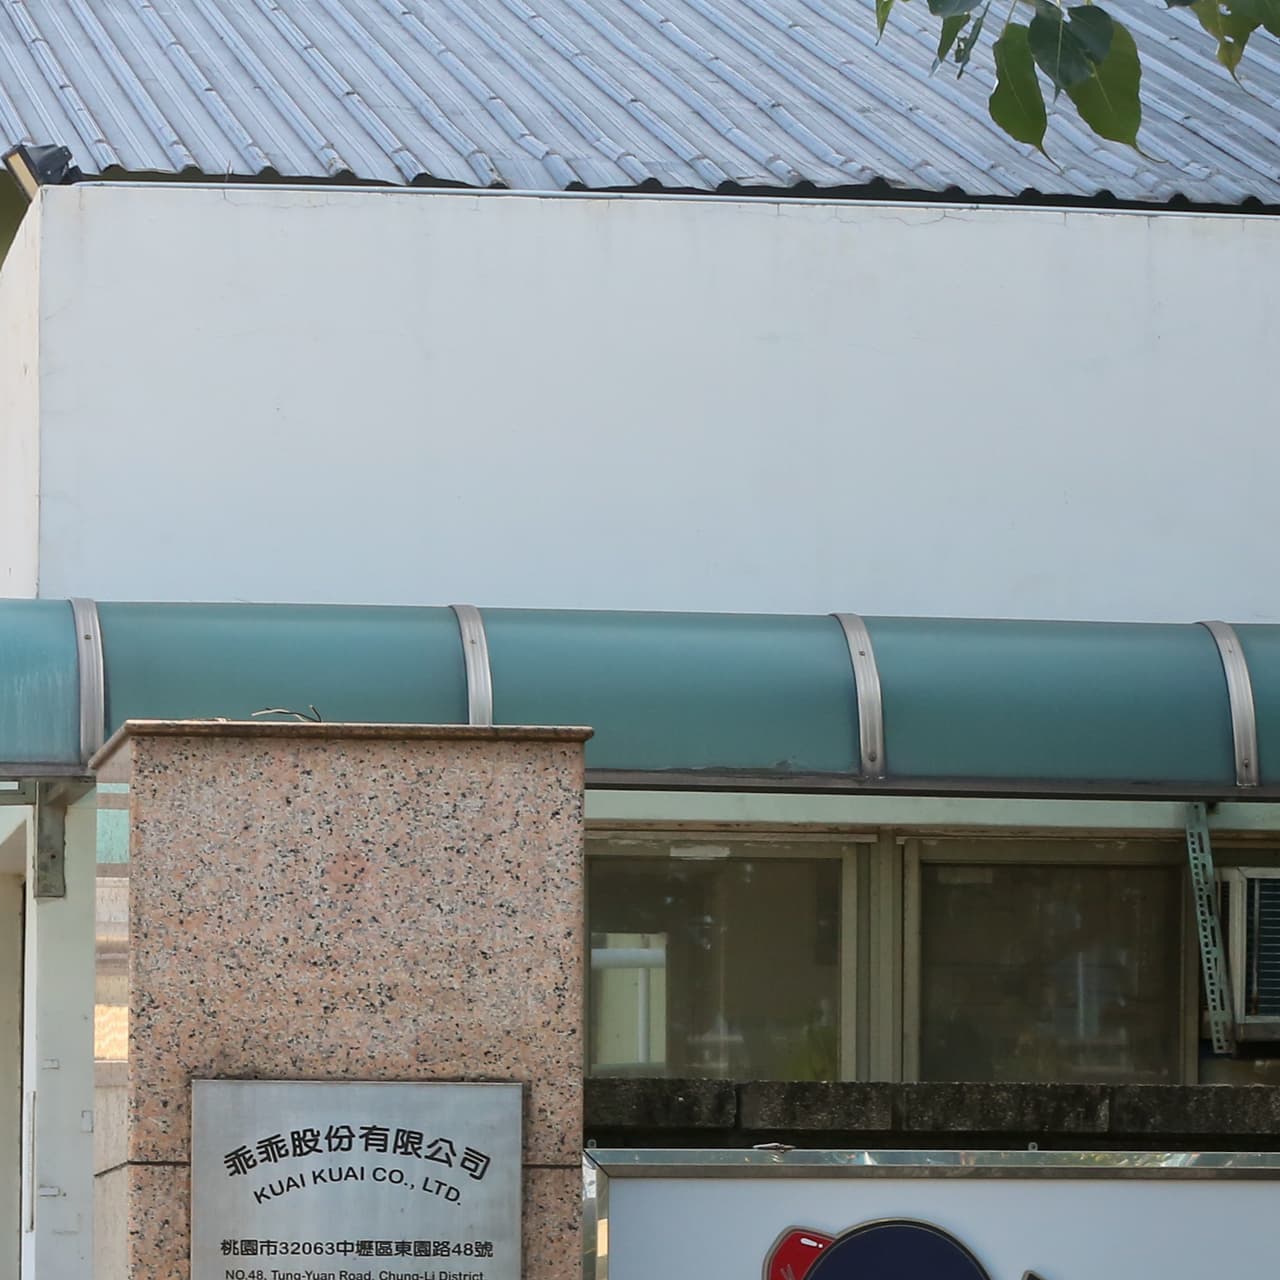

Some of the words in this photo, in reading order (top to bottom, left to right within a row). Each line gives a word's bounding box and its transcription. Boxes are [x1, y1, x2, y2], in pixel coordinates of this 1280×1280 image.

[223, 1125, 491, 1180] 乖乖股份有限公司
[253, 1173, 306, 1204] KUAI
[312, 1166, 365, 1185] KUAI
[372, 1166, 415, 1190] CO.,
[422, 1177, 462, 1206] LTD.
[220, 1239, 494, 1258] 桃園市32063中壢區東園路48號
